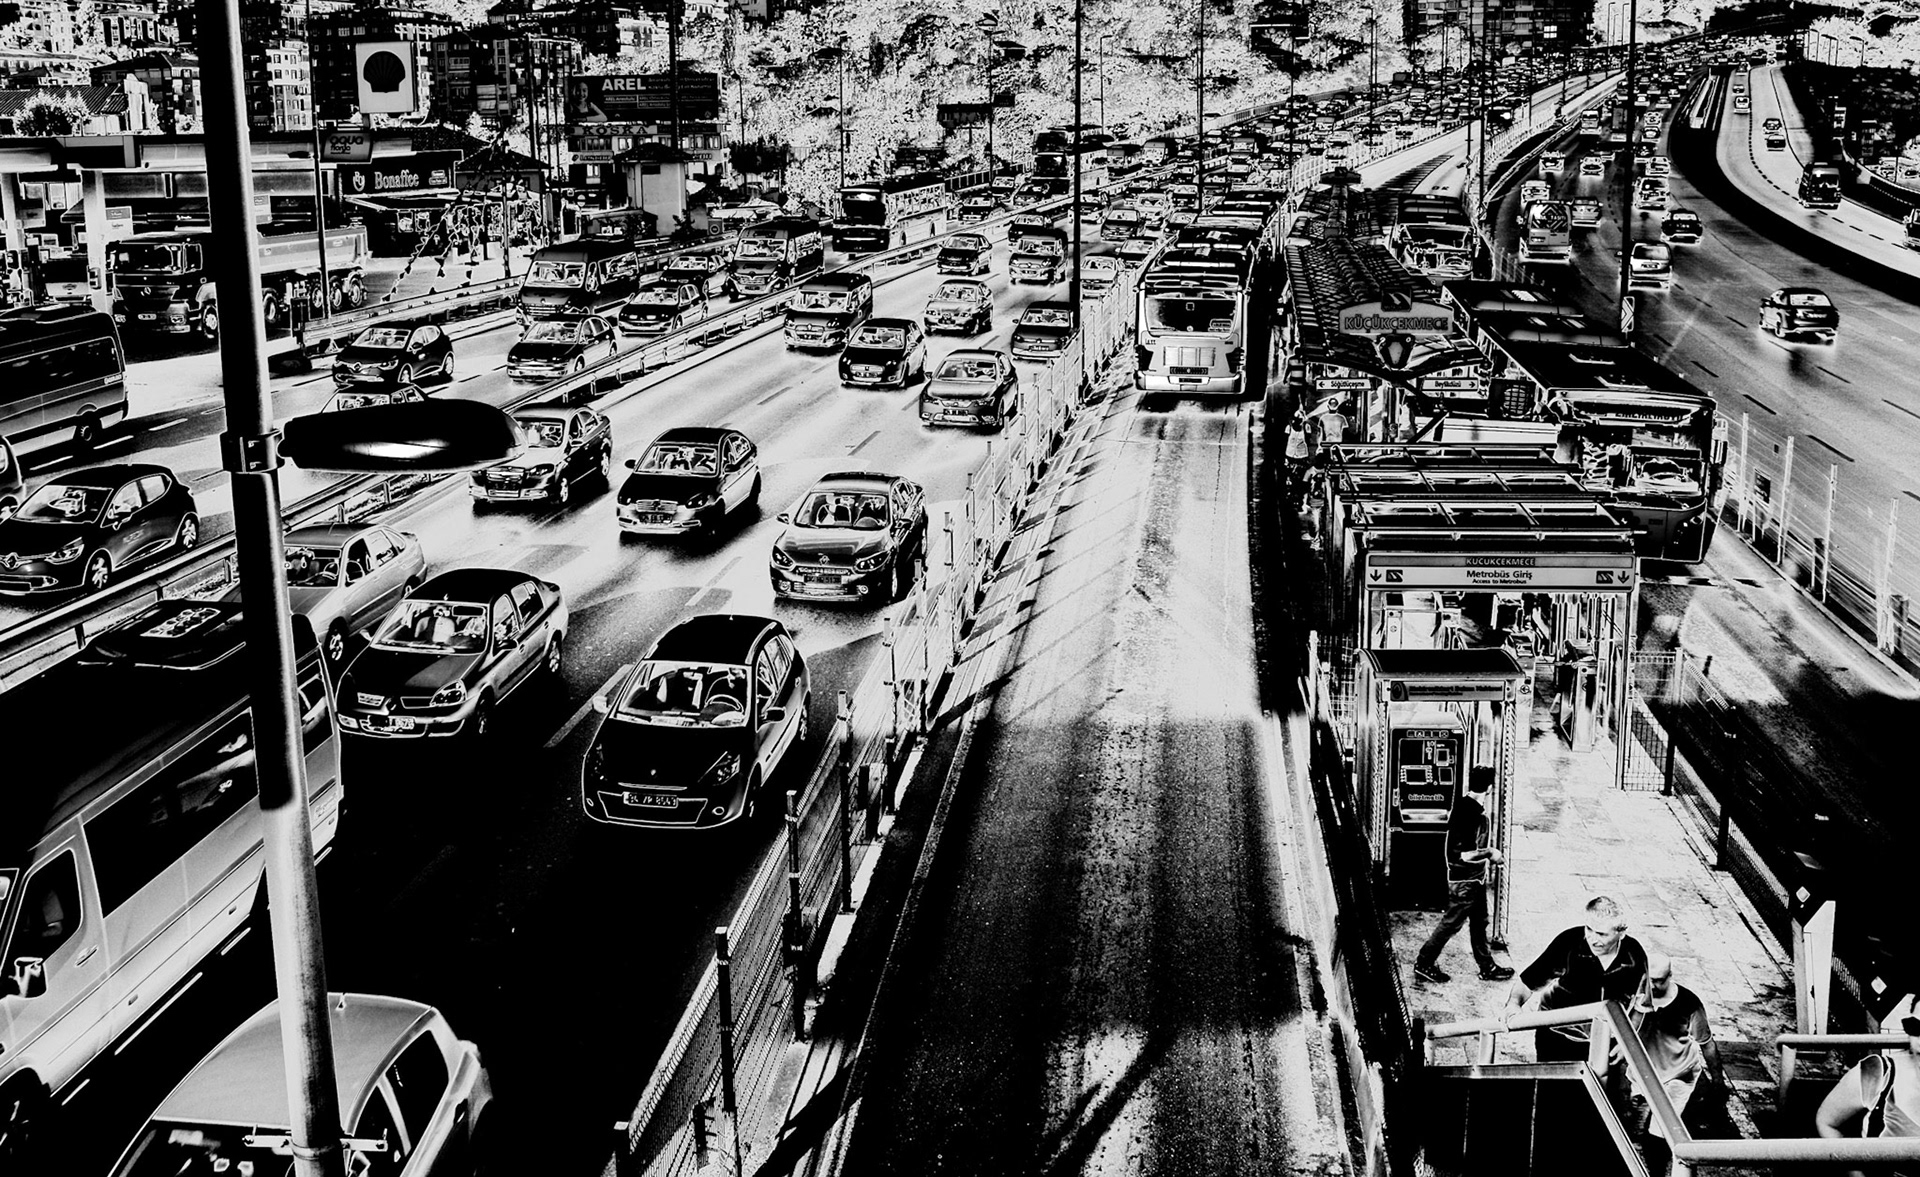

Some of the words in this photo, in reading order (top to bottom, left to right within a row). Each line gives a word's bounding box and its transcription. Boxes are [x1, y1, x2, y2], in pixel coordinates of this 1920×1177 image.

[602, 78, 646, 91] AREL
[374, 169, 419, 189] Bonaffee
[1344, 314, 1449, 333] KÜÇÜKÇEKMECE
[1466, 570, 1510, 579] Metrobüs
[1513, 570, 1533, 580] Giriş
